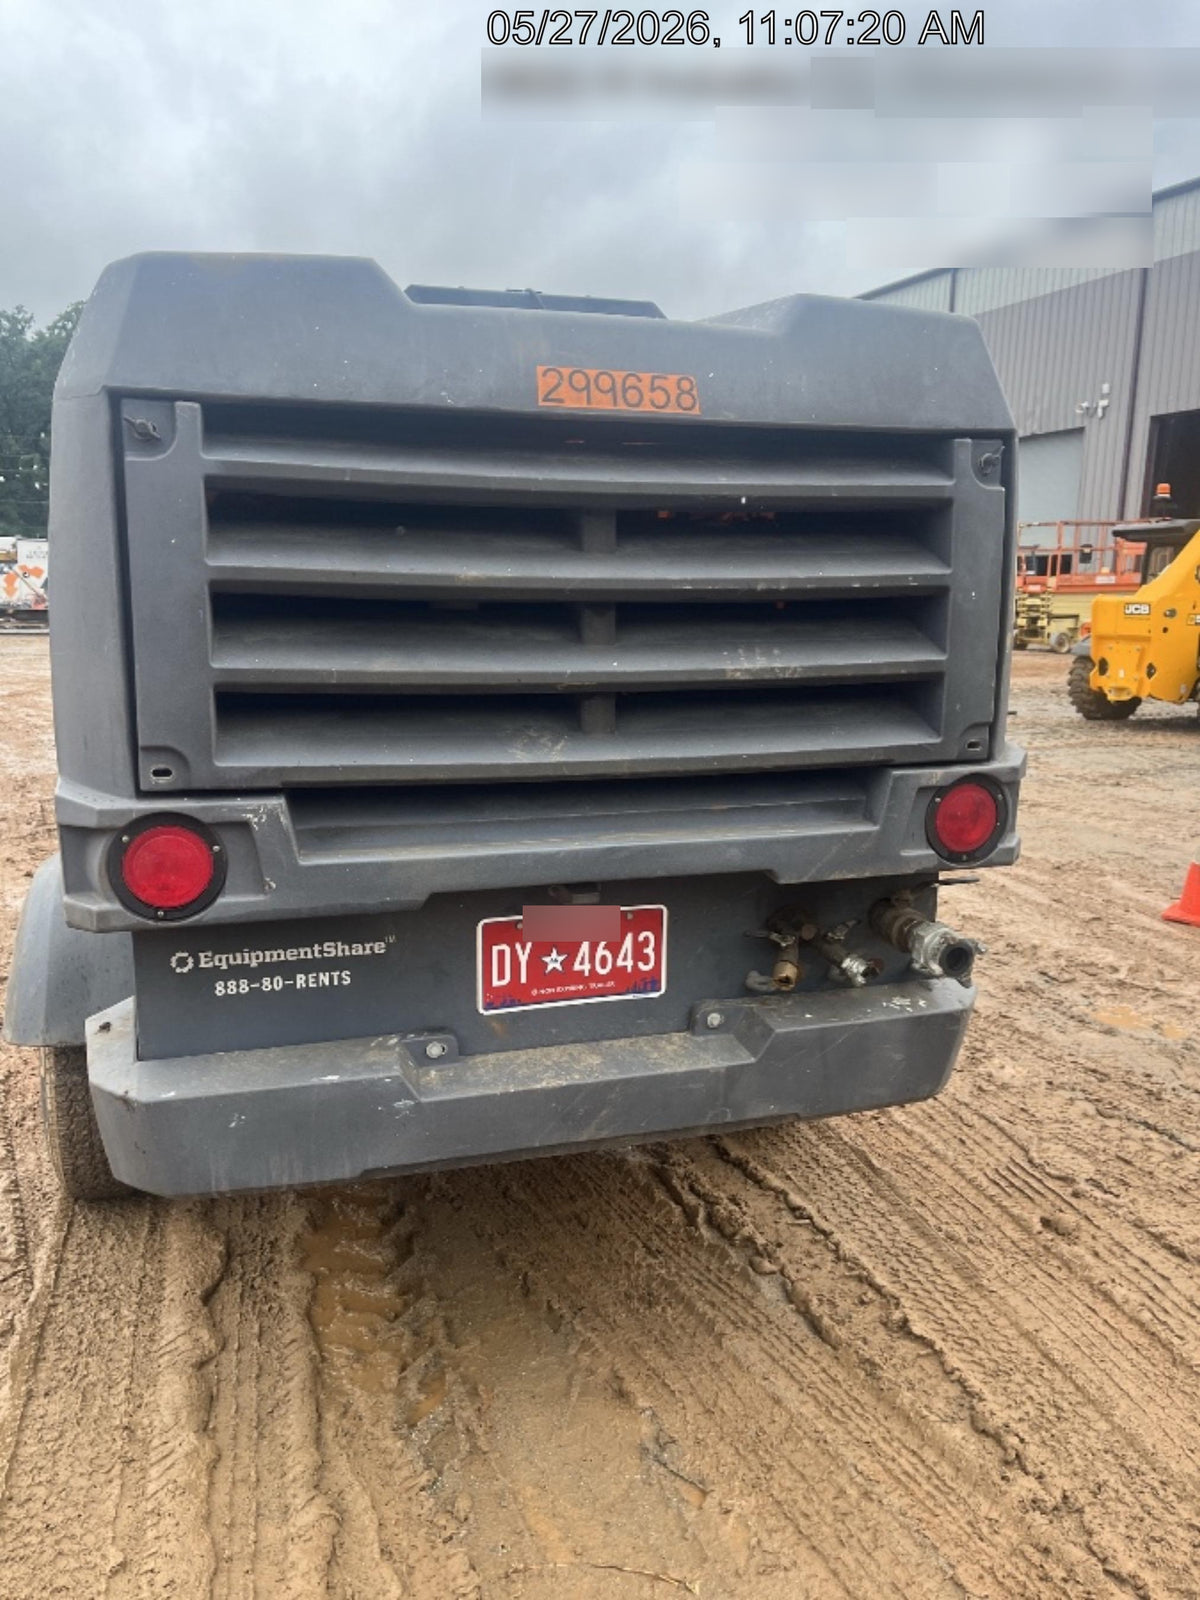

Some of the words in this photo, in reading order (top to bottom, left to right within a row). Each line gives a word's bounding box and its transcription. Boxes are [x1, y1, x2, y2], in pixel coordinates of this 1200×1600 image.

[541, 367, 697, 411] 299658
[1125, 603, 1150, 615] JCB
[198, 941, 387, 969] EquipmentShare
[214, 970, 351, 996] 888-80-RENTS
